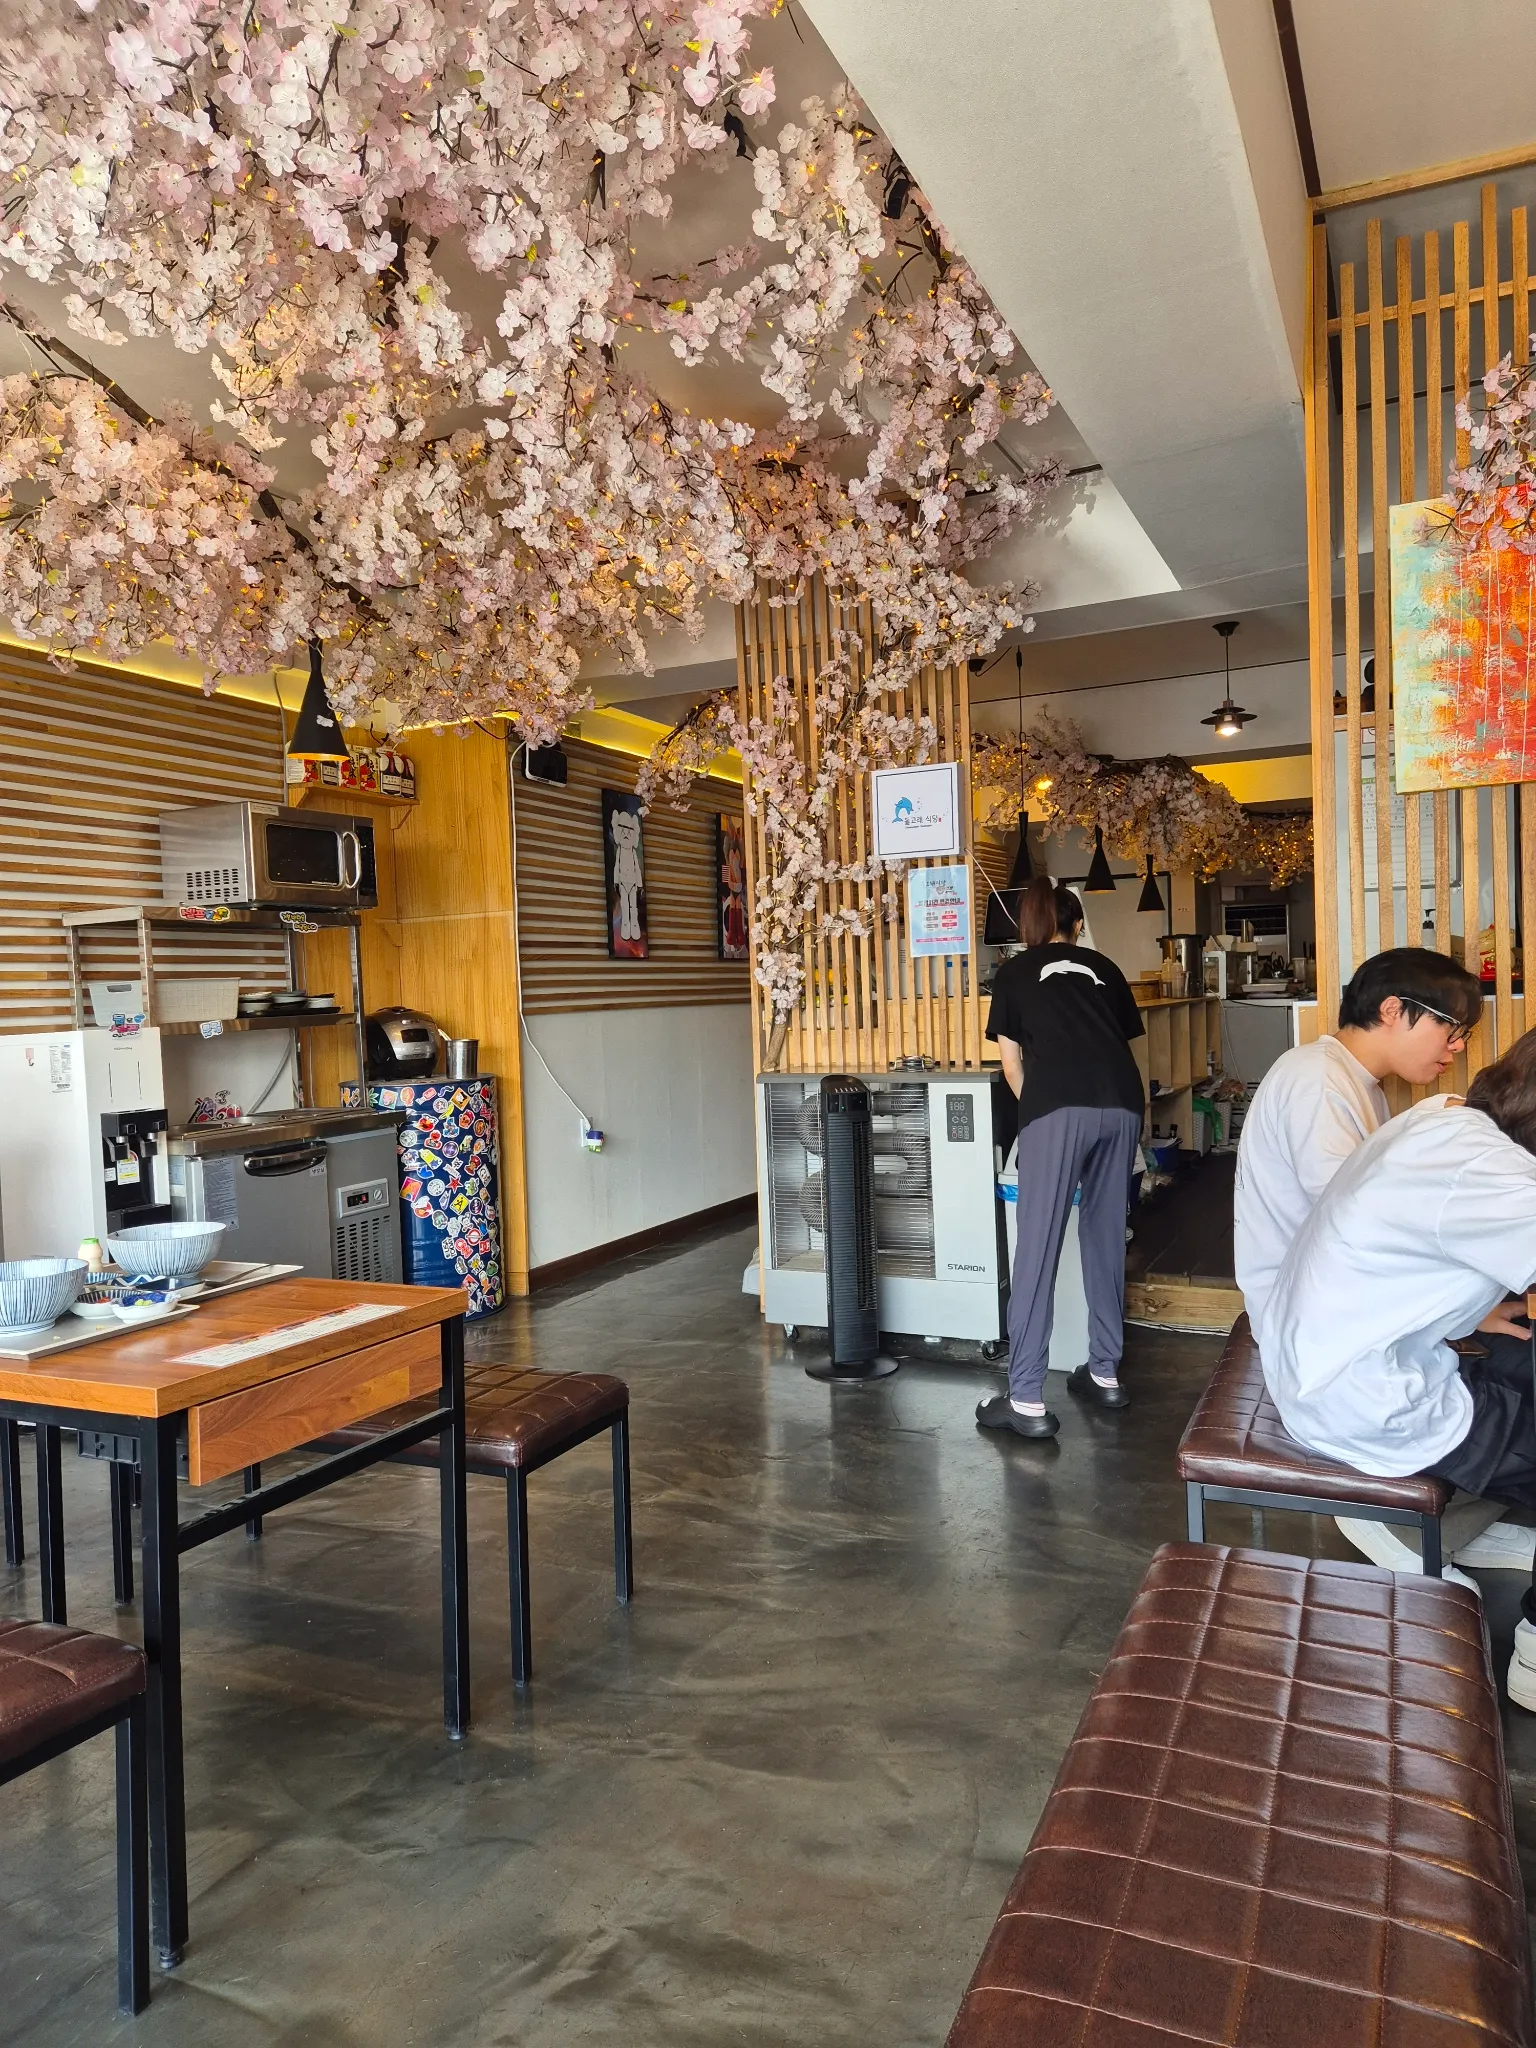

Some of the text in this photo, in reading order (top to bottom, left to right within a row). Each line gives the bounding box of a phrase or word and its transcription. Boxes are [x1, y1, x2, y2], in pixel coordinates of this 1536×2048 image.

[904, 814, 938, 825] 돌고래 식당
[947, 1263, 986, 1272] STARION
